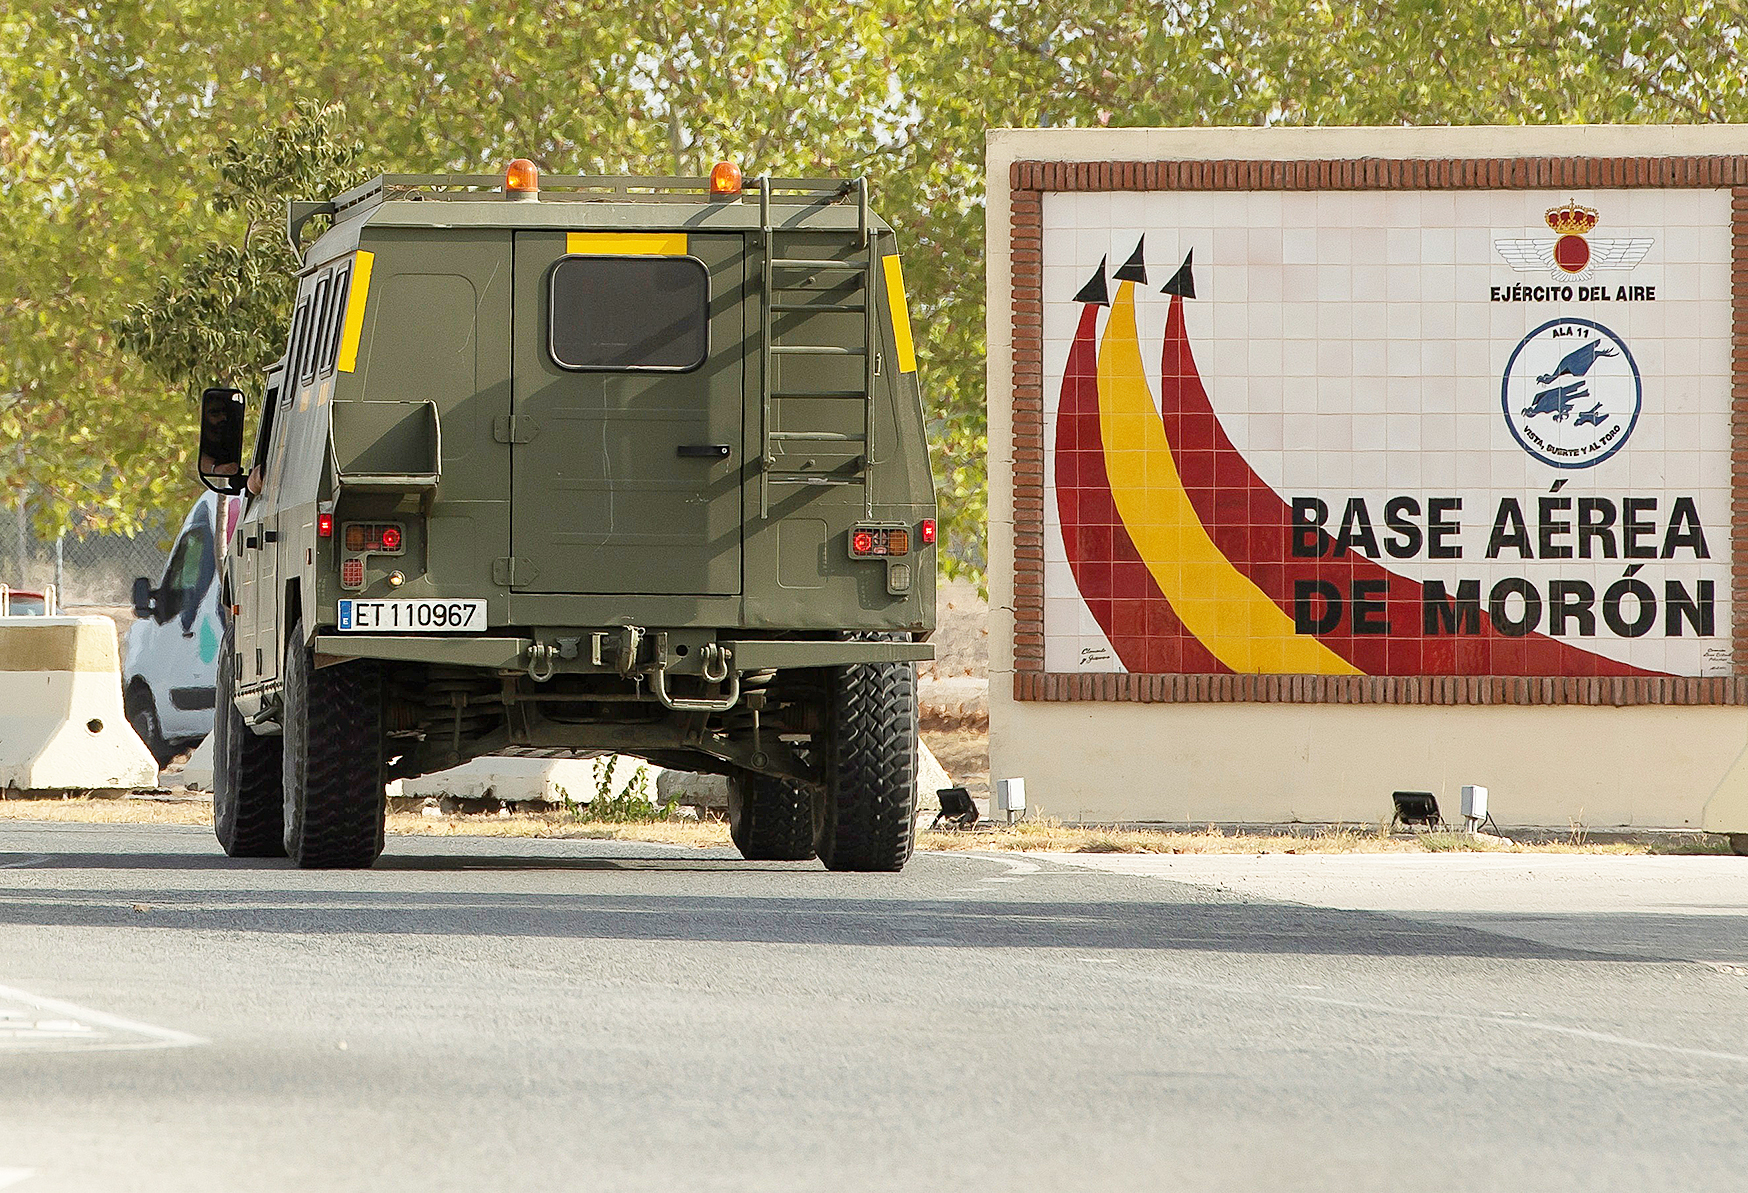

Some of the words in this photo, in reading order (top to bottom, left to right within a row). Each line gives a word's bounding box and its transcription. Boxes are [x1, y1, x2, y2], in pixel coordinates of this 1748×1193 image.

[1490, 282, 1573, 302] EJÉRCITO
[1578, 286, 1611, 302] DEL
[1615, 286, 1656, 302] AIRE
[1552, 325, 1573, 339] ALA
[1577, 327, 1589, 339] 11
[1523, 425, 1545, 450] VISTA,
[1580, 447, 1588, 455] Y
[1588, 441, 1602, 452] AL
[1599, 424, 1621, 446] TORO
[1290, 496, 1463, 559] BASE
[1485, 479, 1712, 560] AÉREA
[1293, 579, 1392, 635] DE
[1422, 564, 1715, 637] MORÓN
